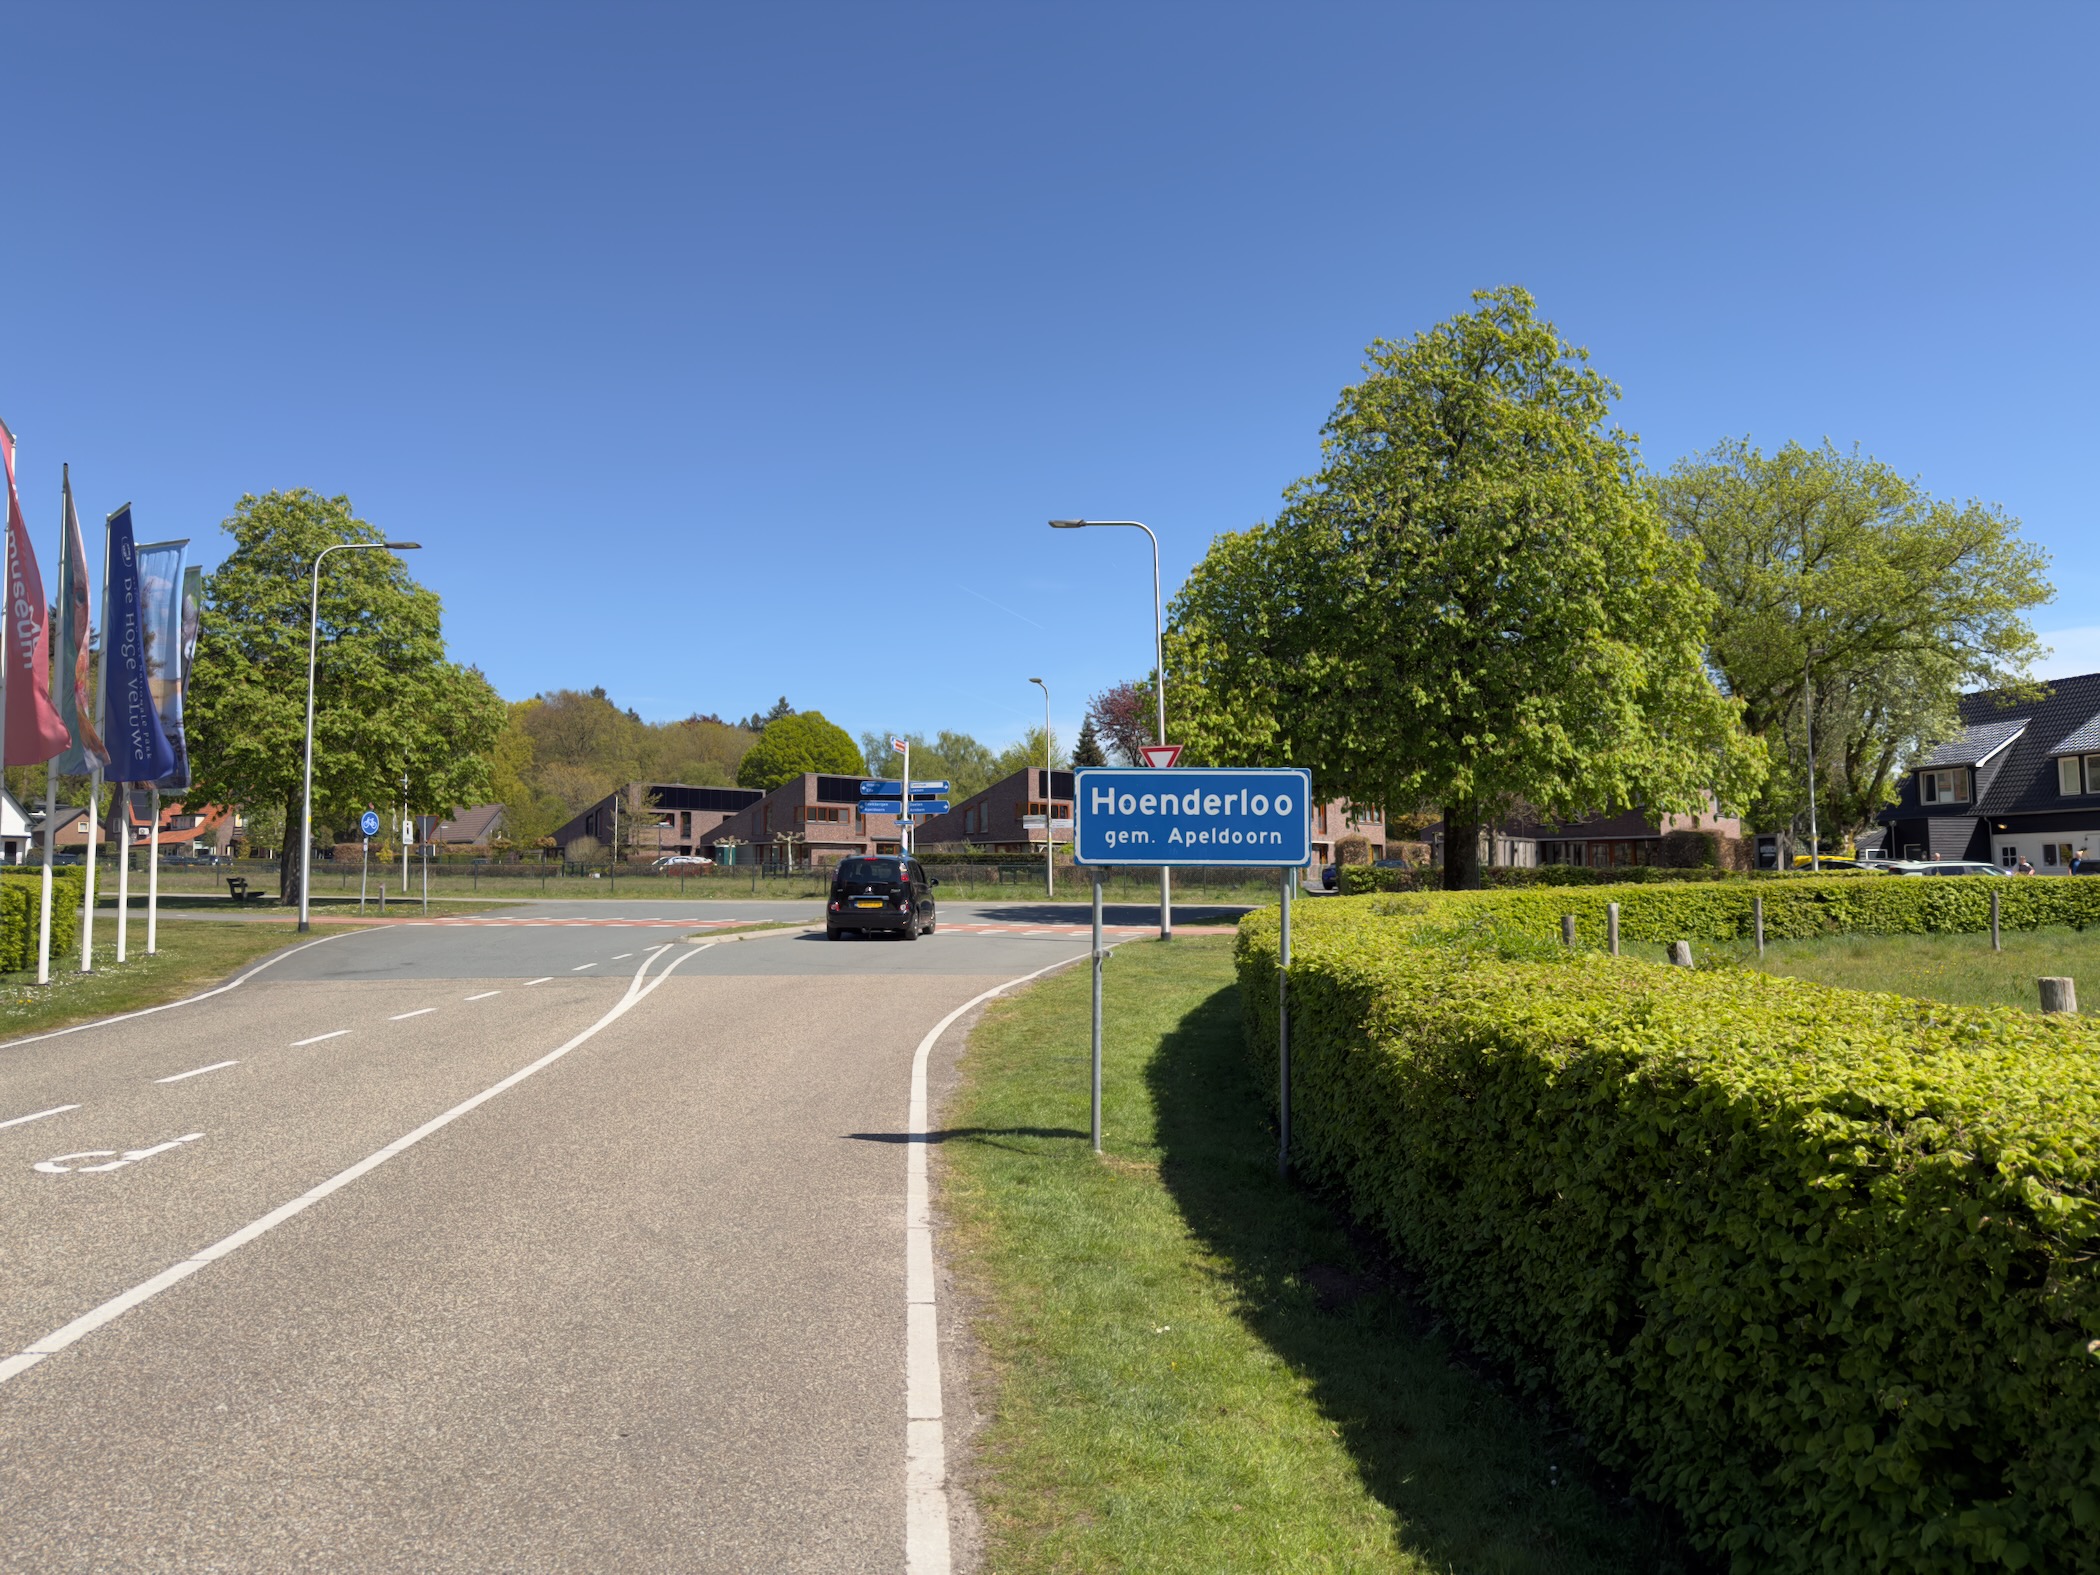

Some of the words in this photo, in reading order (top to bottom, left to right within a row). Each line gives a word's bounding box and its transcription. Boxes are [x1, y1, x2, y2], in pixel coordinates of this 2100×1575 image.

[1091, 787, 1293, 816] Hoenderloo
[1104, 829, 1156, 848] gem.
[1167, 827, 1282, 848] Apeldoorn
